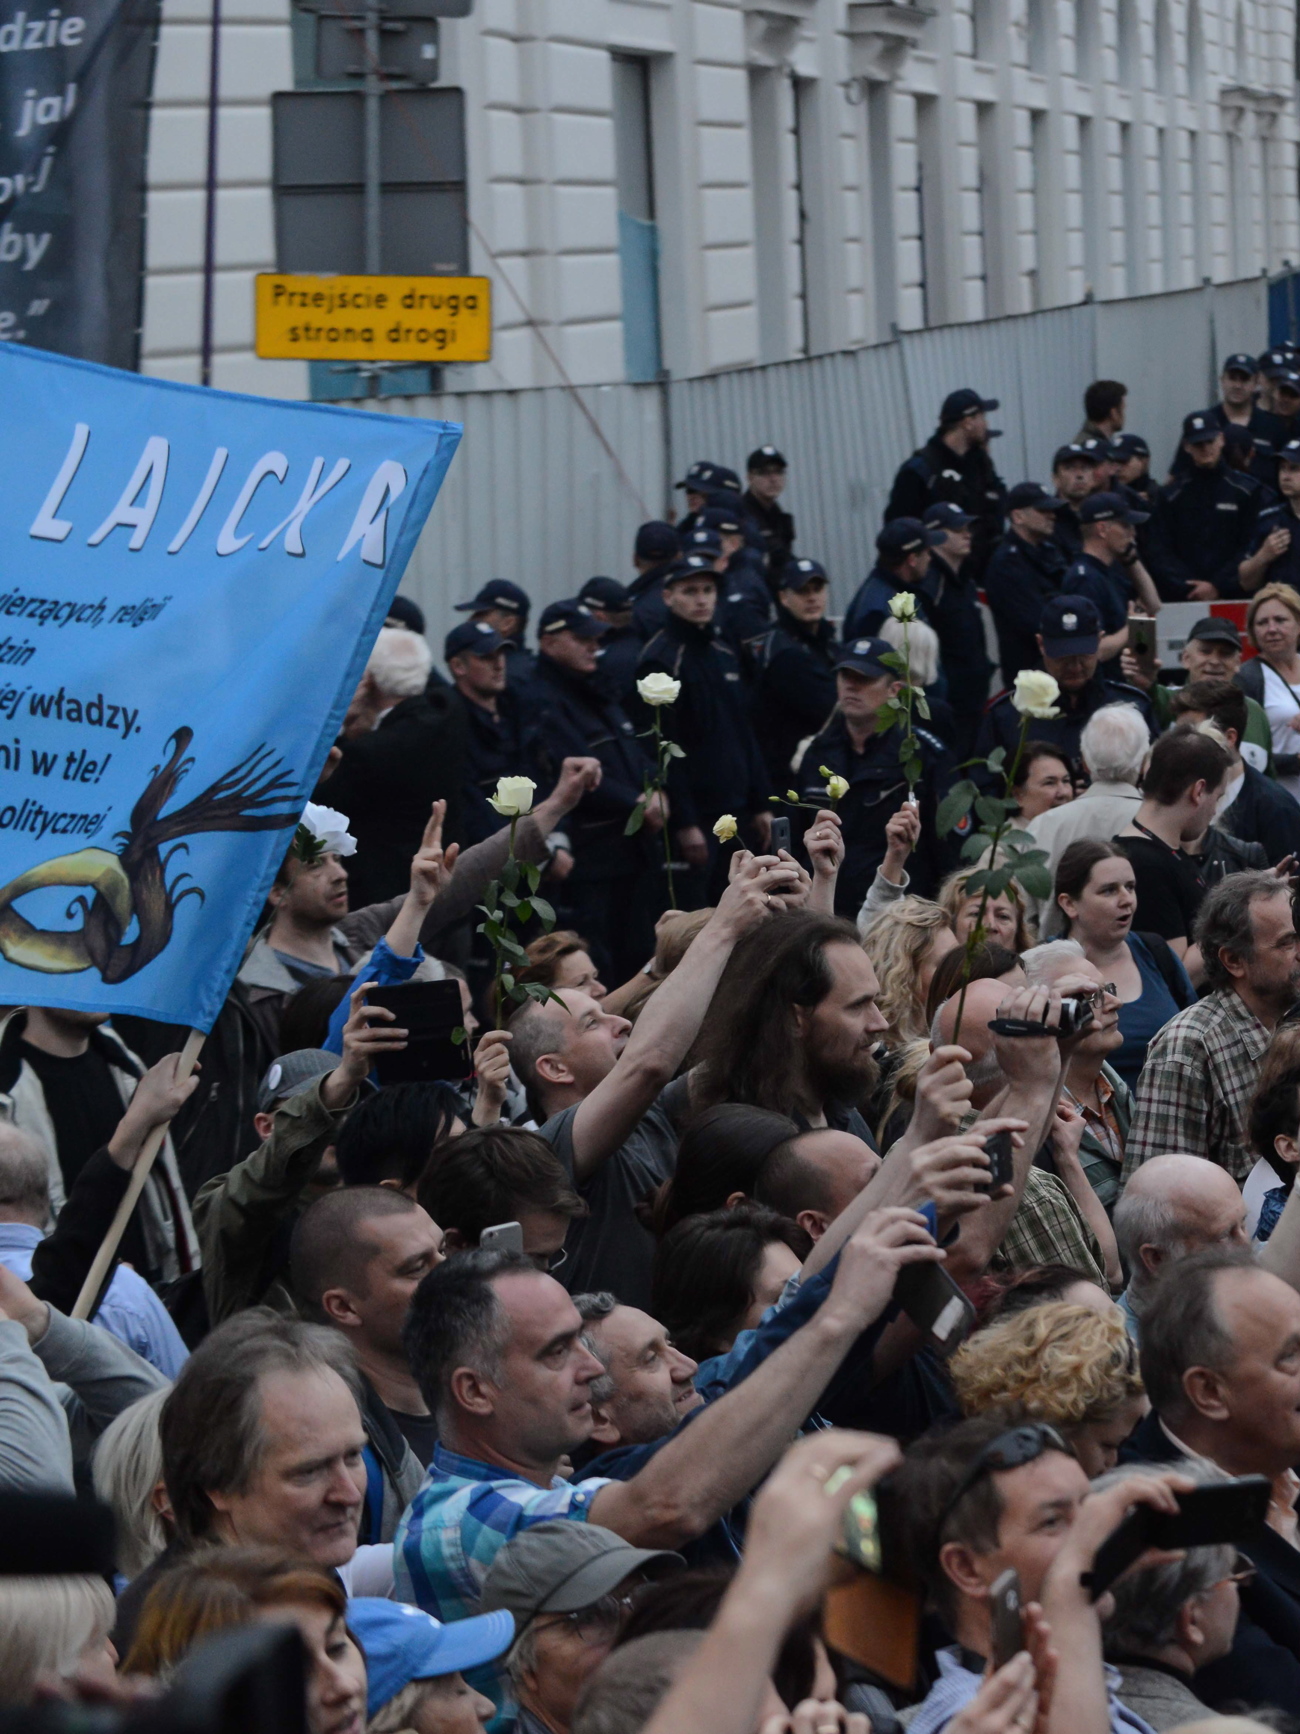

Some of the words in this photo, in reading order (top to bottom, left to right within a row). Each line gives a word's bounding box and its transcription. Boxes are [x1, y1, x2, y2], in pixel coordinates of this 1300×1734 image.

[272, 283, 388, 315] Przejście
[386, 320, 457, 351] drogi
[29, 687, 141, 740] władzy.
[31, 749, 58, 777] w
[62, 748, 112, 784] tle!
